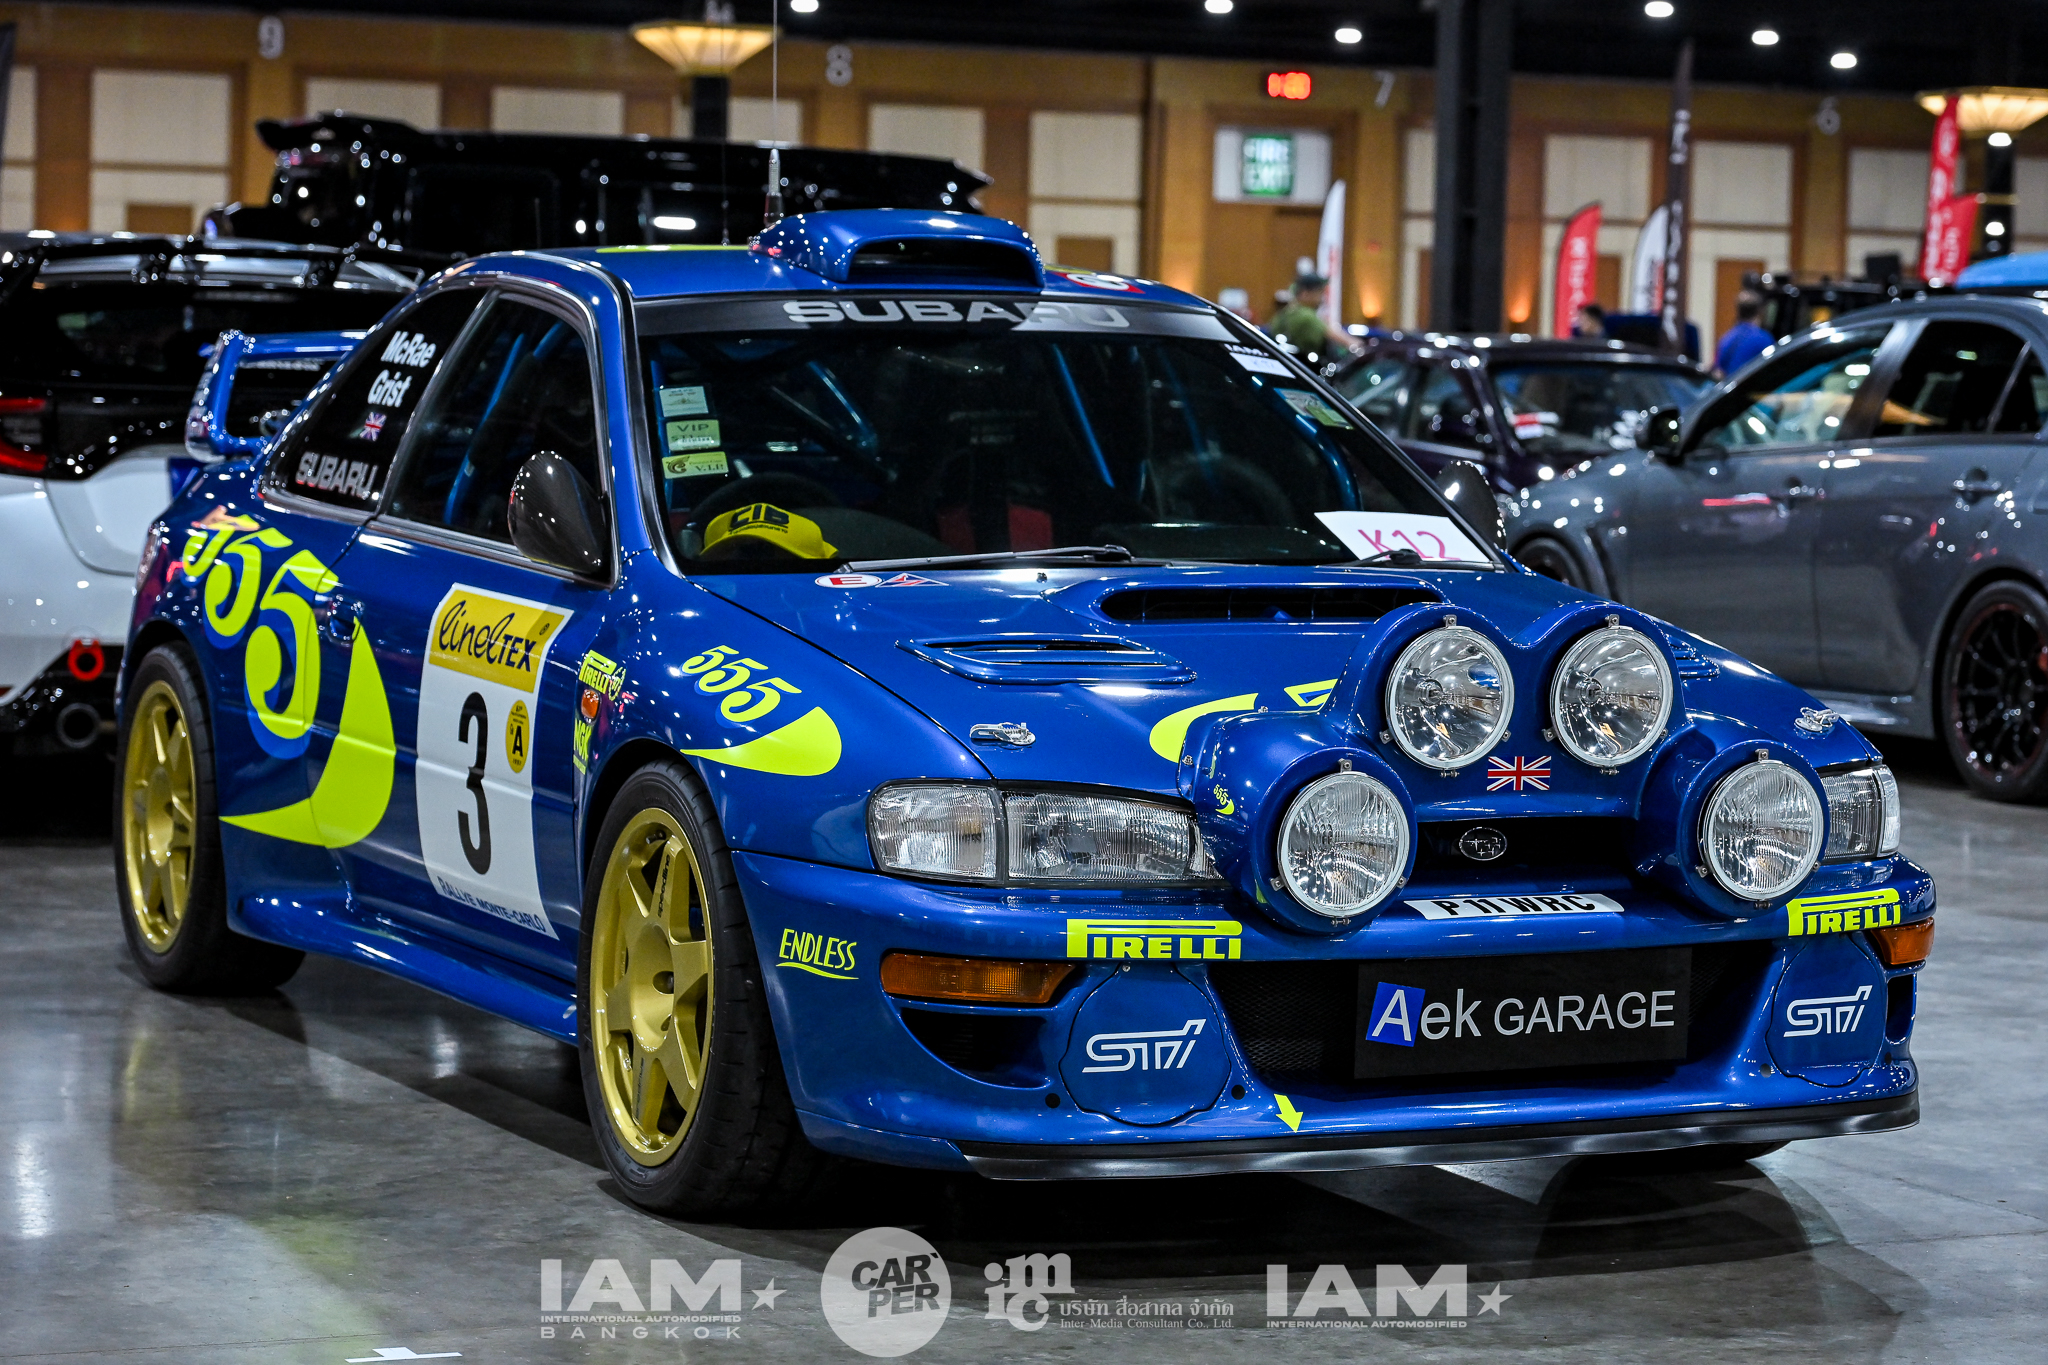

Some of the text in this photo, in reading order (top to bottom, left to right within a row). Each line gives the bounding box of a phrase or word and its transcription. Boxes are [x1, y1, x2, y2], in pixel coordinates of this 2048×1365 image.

[258, 15, 285, 59] 9
[826, 44, 854, 87] 8
[783, 300, 1130, 328] SUBARU
[381, 331, 436, 368] McRae
[367, 369, 412, 407] Grist
[677, 423, 709, 432] VIP
[295, 451, 378, 499] SUBARU
[579, 650, 617, 694] PIRELLI
[682, 645, 802, 722] 555
[512, 725, 523, 757] A
[457, 691, 491, 876] 3
[1213, 784, 1229, 805] 555
[437, 876, 547, 932] RALLYE MONTE-CARLO
[1786, 888, 1901, 936] PIRELLI
[779, 928, 857, 971] ENDLESS
[1067, 919, 1242, 959] PIRELLI
[1372, 988, 1675, 1042] Aek GARAGE
